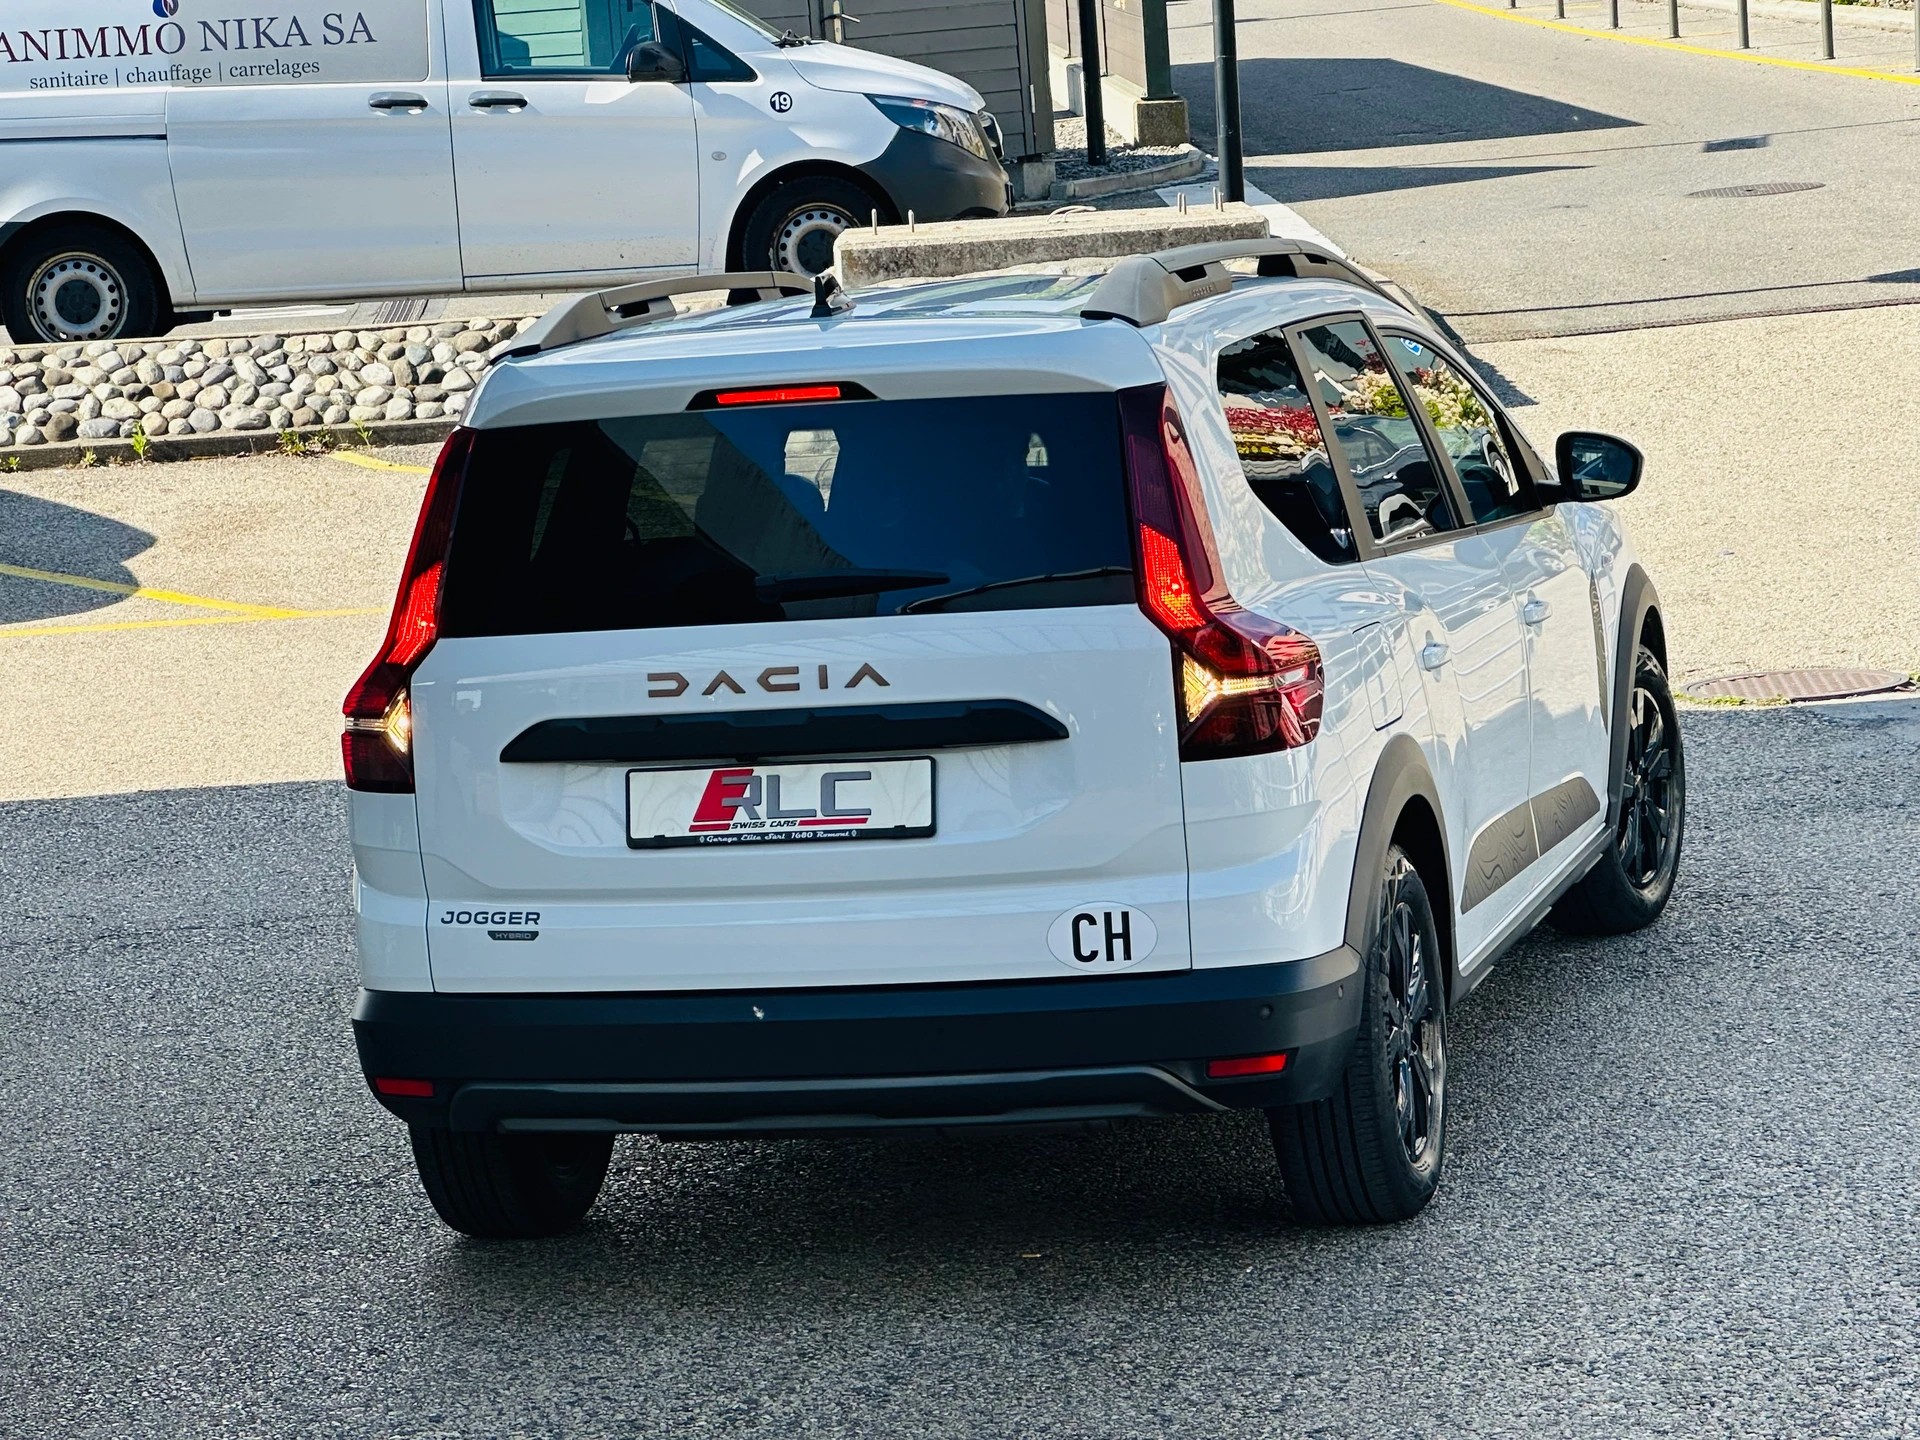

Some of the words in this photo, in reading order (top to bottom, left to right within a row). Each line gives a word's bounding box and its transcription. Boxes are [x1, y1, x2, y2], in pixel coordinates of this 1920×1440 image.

[197, 15, 312, 52] NIKA
[322, 12, 378, 46] SA
[30, 71, 109, 89] sanitaire
[126, 64, 212, 84] chauffage
[229, 59, 320, 79] carrelages
[771, 93, 791, 110] 19
[647, 662, 891, 698] DACIA
[731, 821, 766, 830] SWISS
[769, 819, 798, 828] CARS
[706, 835, 738, 843] Garage
[791, 831, 814, 839] 1680
[816, 830, 850, 838] Romont
[440, 911, 541, 925] JOGGER
[495, 932, 532, 940] HYBRID
[1071, 911, 1132, 963] CH
